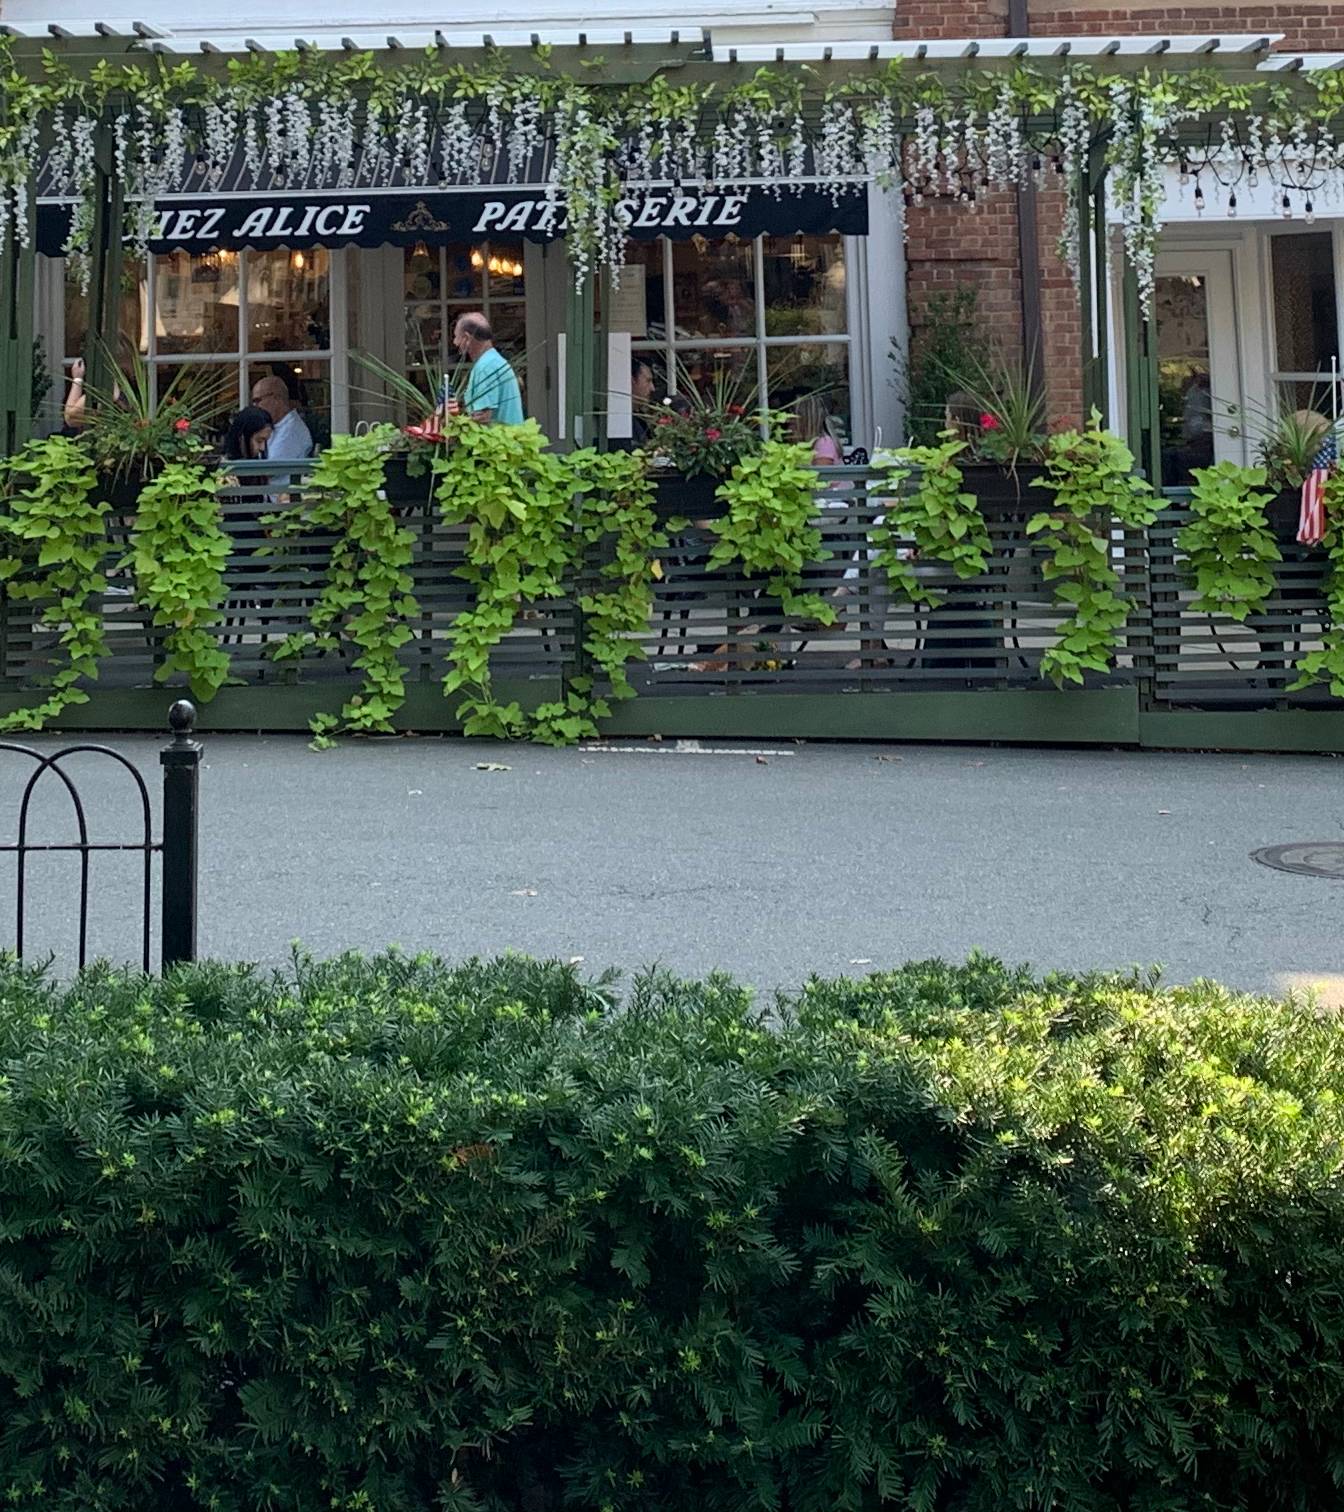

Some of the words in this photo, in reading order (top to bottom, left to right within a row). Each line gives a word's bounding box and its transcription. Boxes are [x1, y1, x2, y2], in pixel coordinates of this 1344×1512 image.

[122, 208, 226, 241] HEZ
[232, 205, 371, 237] ALICE
[472, 194, 749, 232] PATSERIE
